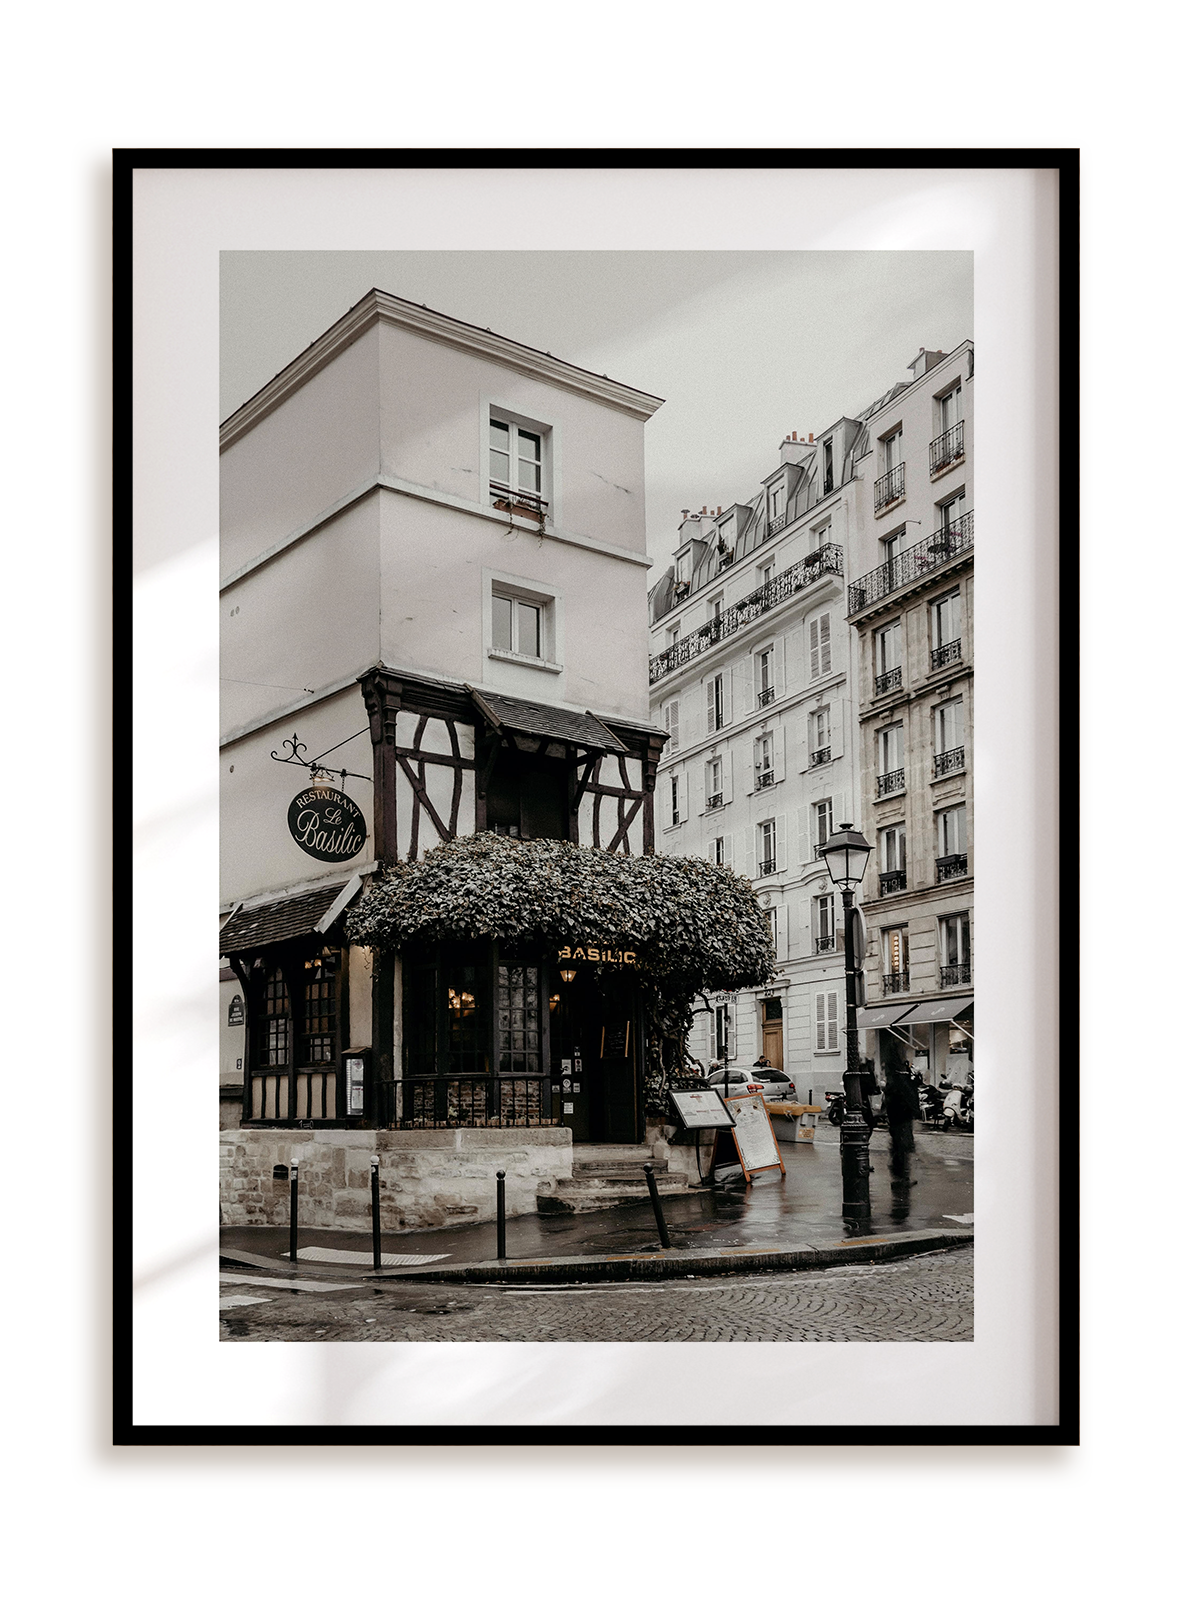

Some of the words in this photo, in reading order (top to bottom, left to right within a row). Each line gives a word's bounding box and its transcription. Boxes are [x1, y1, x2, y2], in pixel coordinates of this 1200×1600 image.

[295, 789, 361, 818] RESTAURANT
[323, 807, 342, 825] Le
[294, 809, 363, 854] Basilic
